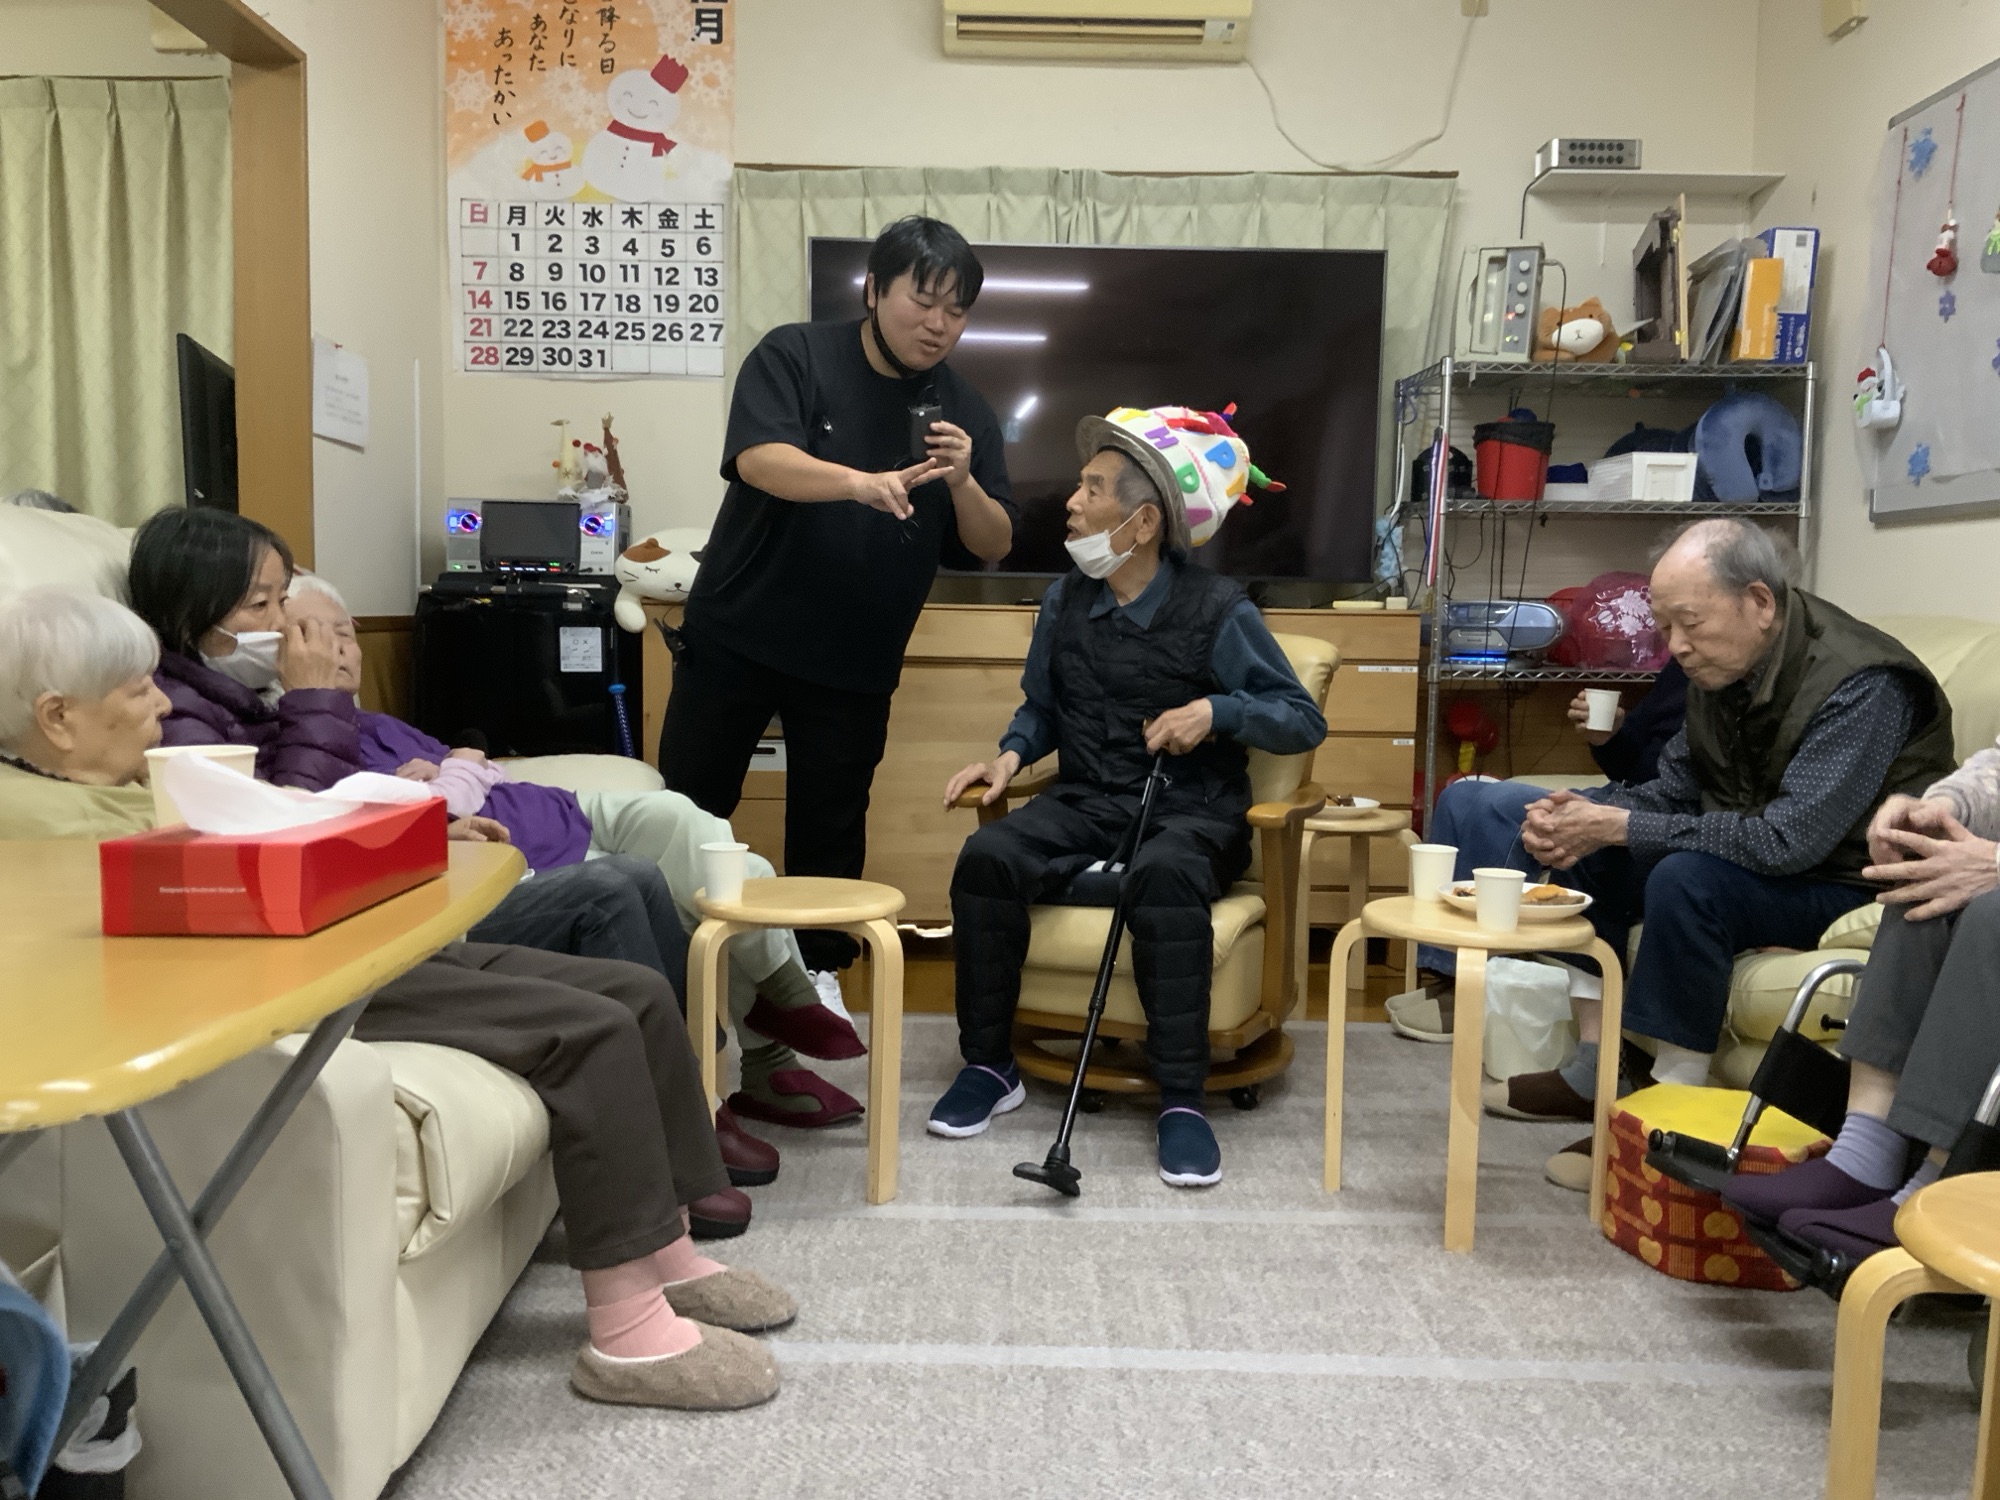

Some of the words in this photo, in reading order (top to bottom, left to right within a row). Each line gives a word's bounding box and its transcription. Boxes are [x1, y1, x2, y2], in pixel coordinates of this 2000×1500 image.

[529, 14, 548, 72] あなた
[559, 0, 580, 67] なりに
[596, 0, 621, 75] 降る日
[492, 28, 515, 125] あったかい
[470, 203, 488, 224] 日
[506, 206, 526, 226] 月
[544, 206, 566, 226] 火
[582, 207, 603, 228] 水
[622, 208, 642, 228] 木
[658, 208, 679, 229] 金
[694, 210, 715, 230] 土
[512, 233, 520, 251] 1
[548, 234, 562, 252] 2
[584, 236, 600, 254] 3
[622, 238, 638, 256] 4
[660, 239, 675, 257] 5
[696, 236, 712, 256] 6
[472, 262, 488, 280] 7
[509, 262, 524, 281] 8
[548, 263, 562, 281] 9
[579, 264, 606, 282] 10
[620, 264, 639, 282] 11
[654, 267, 680, 286] 12
[694, 268, 718, 286] 13
[468, 290, 492, 309] 14
[504, 291, 530, 310] 15
[541, 292, 566, 311] 16
[580, 293, 606, 312] 17
[614, 294, 641, 313] 18
[654, 294, 680, 313] 19
[688, 294, 718, 313] 20
[470, 318, 492, 337] 21
[504, 319, 534, 337] 22
[542, 320, 571, 338] 23
[578, 320, 609, 338] 24
[614, 322, 646, 340] 25
[652, 322, 683, 342] 26
[690, 324, 724, 342] 27
[470, 346, 499, 365] 28
[505, 346, 534, 366] 29
[542, 347, 572, 366] 30
[578, 349, 606, 368] 31
